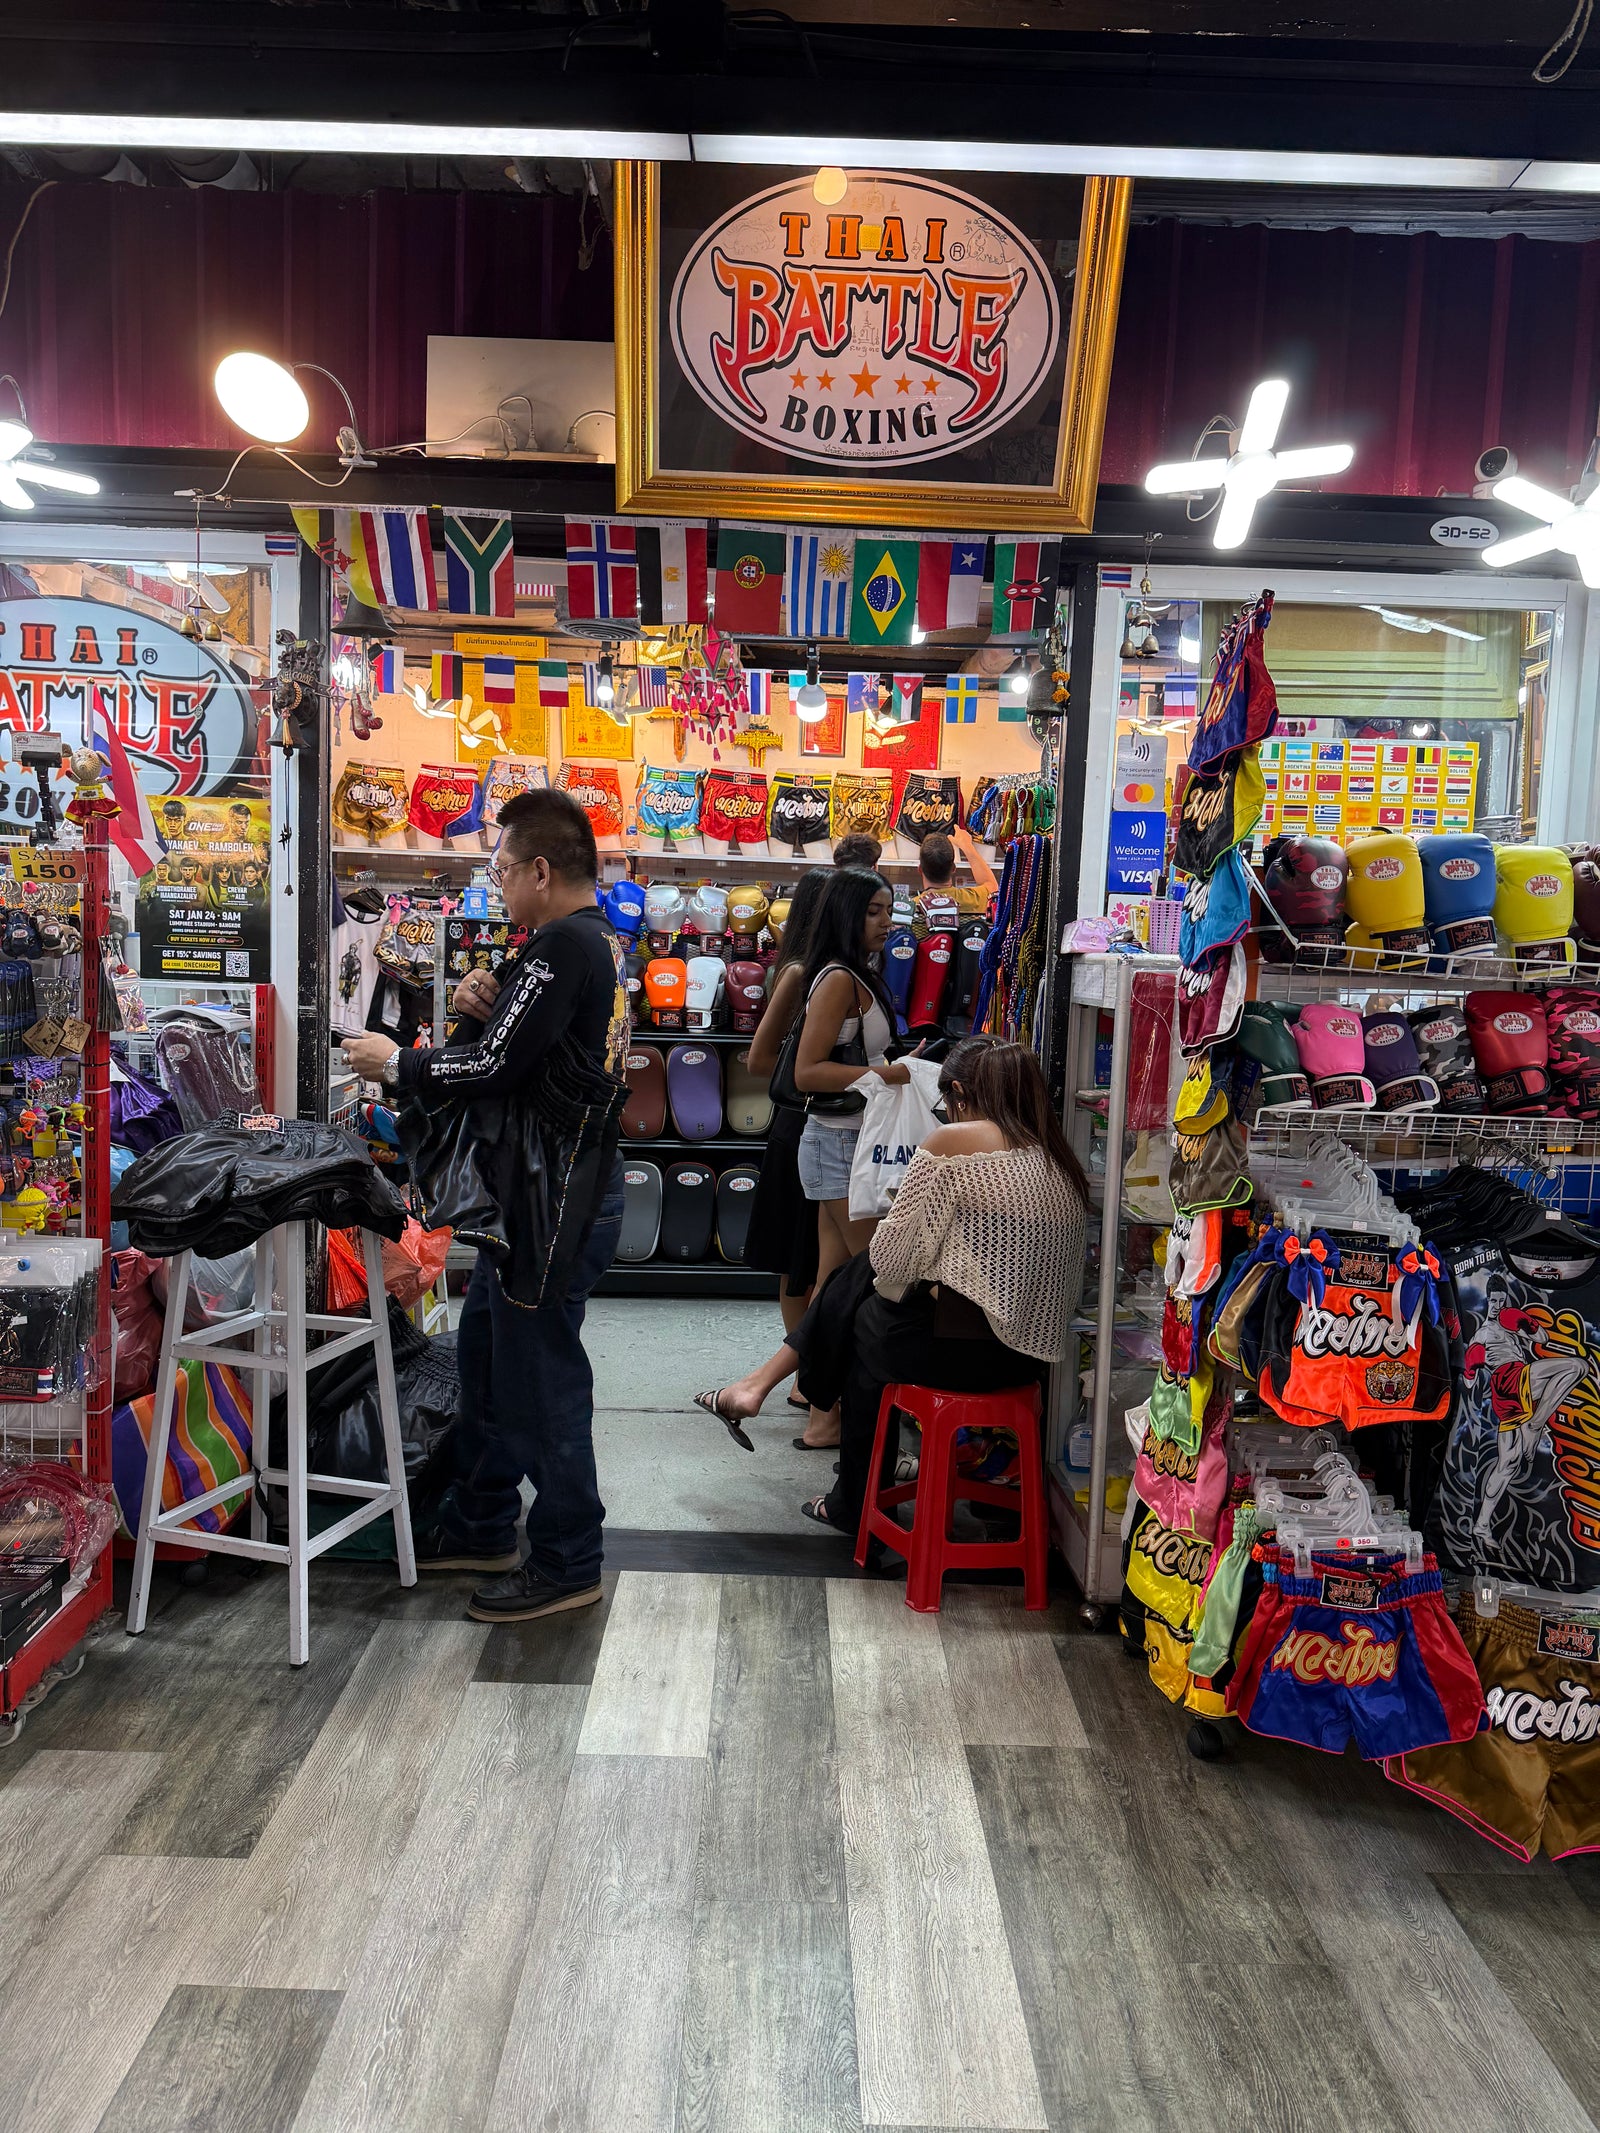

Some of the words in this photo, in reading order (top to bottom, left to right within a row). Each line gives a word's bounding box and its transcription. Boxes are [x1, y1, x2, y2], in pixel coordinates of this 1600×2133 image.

[779, 212, 948, 263] THAI
[711, 246, 1028, 434] BATTLE
[779, 394, 937, 446] BOXING
[0, 622, 138, 666] HAI
[0, 665, 220, 798] ATTLE
[715, 793, 764, 818] มวยไทย
[776, 794, 828, 819] มวยไทย
[902, 793, 955, 823] มวยไทย
[188, 822, 212, 832] ONE
[18, 850, 76, 861] SALE
[166, 840, 199, 850] YAKAEV
[208, 840, 254, 853] RAMBOLEK
[1114, 846, 1160, 856] Welcome
[21, 864, 76, 879] 150
[1118, 870, 1154, 883] VISA
[169, 910, 185, 919] SAT
[186, 910, 203, 920] JAN
[205, 911, 216, 920] 24
[222, 911, 241, 921] 9AM
[162, 950, 175, 958] GET
[490, 976, 538, 1052] COWBOY
[1351, 1252, 1375, 1260] THAI
[1453, 1257, 1474, 1275] BORN
[1474, 1253, 1485, 1266] TO
[1486, 1249, 1496, 1261] BE
[1340, 1256, 1385, 1284] BATTLE
[1545, 1626, 1595, 1657] BATTLE
[1557, 1624, 1583, 1634] THAI
[1273, 1621, 1403, 1687] มวยไทย
[1555, 1648, 1582, 1657] BOXING
[1486, 1680, 1600, 1741] มวยไท
